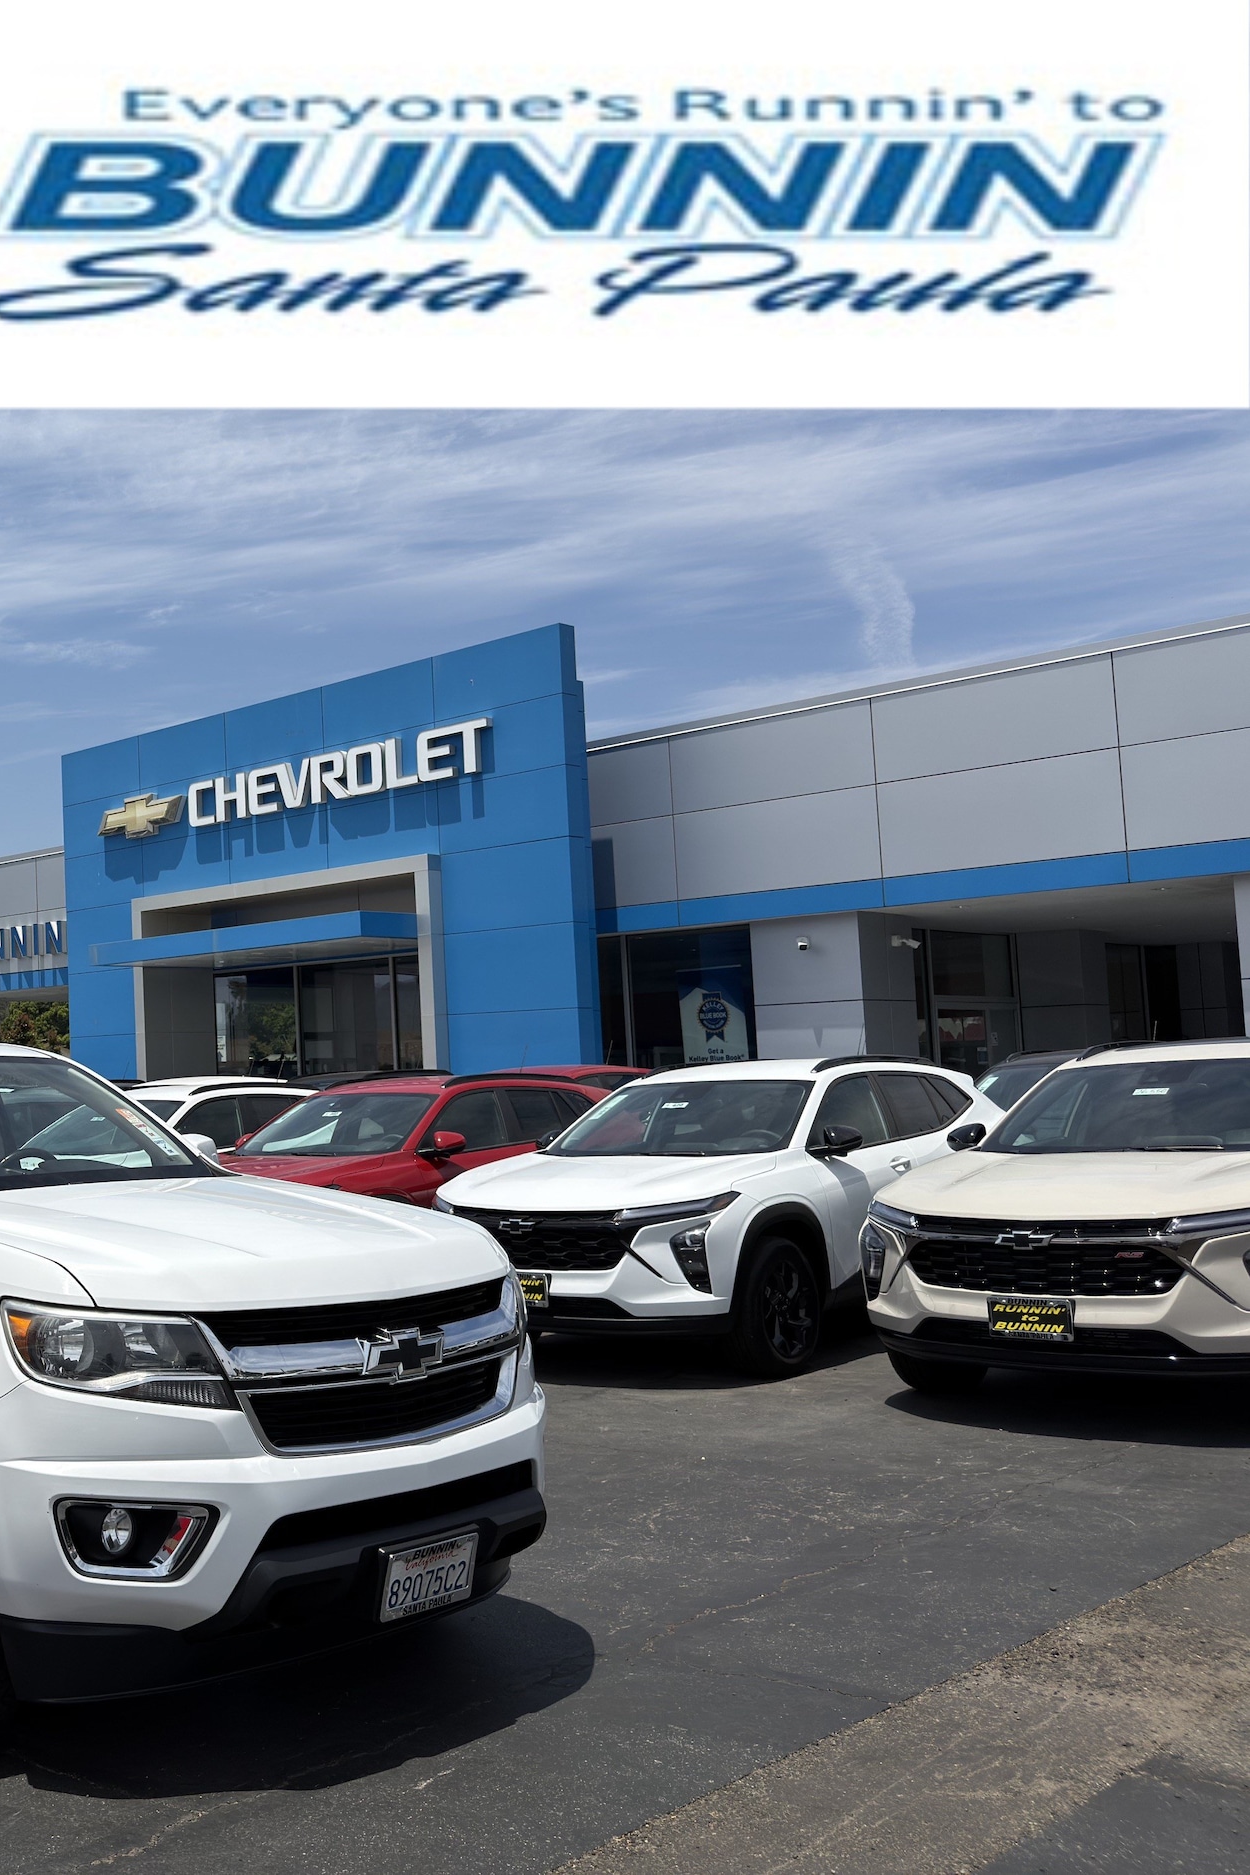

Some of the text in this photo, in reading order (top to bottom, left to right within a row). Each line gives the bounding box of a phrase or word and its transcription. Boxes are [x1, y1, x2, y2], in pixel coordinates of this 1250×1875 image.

[187, 717, 493, 828] CHEVROLET
[992, 1303, 1066, 1315] RUNNIN'
[1021, 1314, 1040, 1322] to
[994, 1321, 1065, 1333] BUNNIN
[405, 1550, 459, 1571] California
[412, 1540, 458, 1561] BUNNIN
[388, 1560, 466, 1608] 89075C2
[402, 1594, 453, 1616] SANTA PAULA
